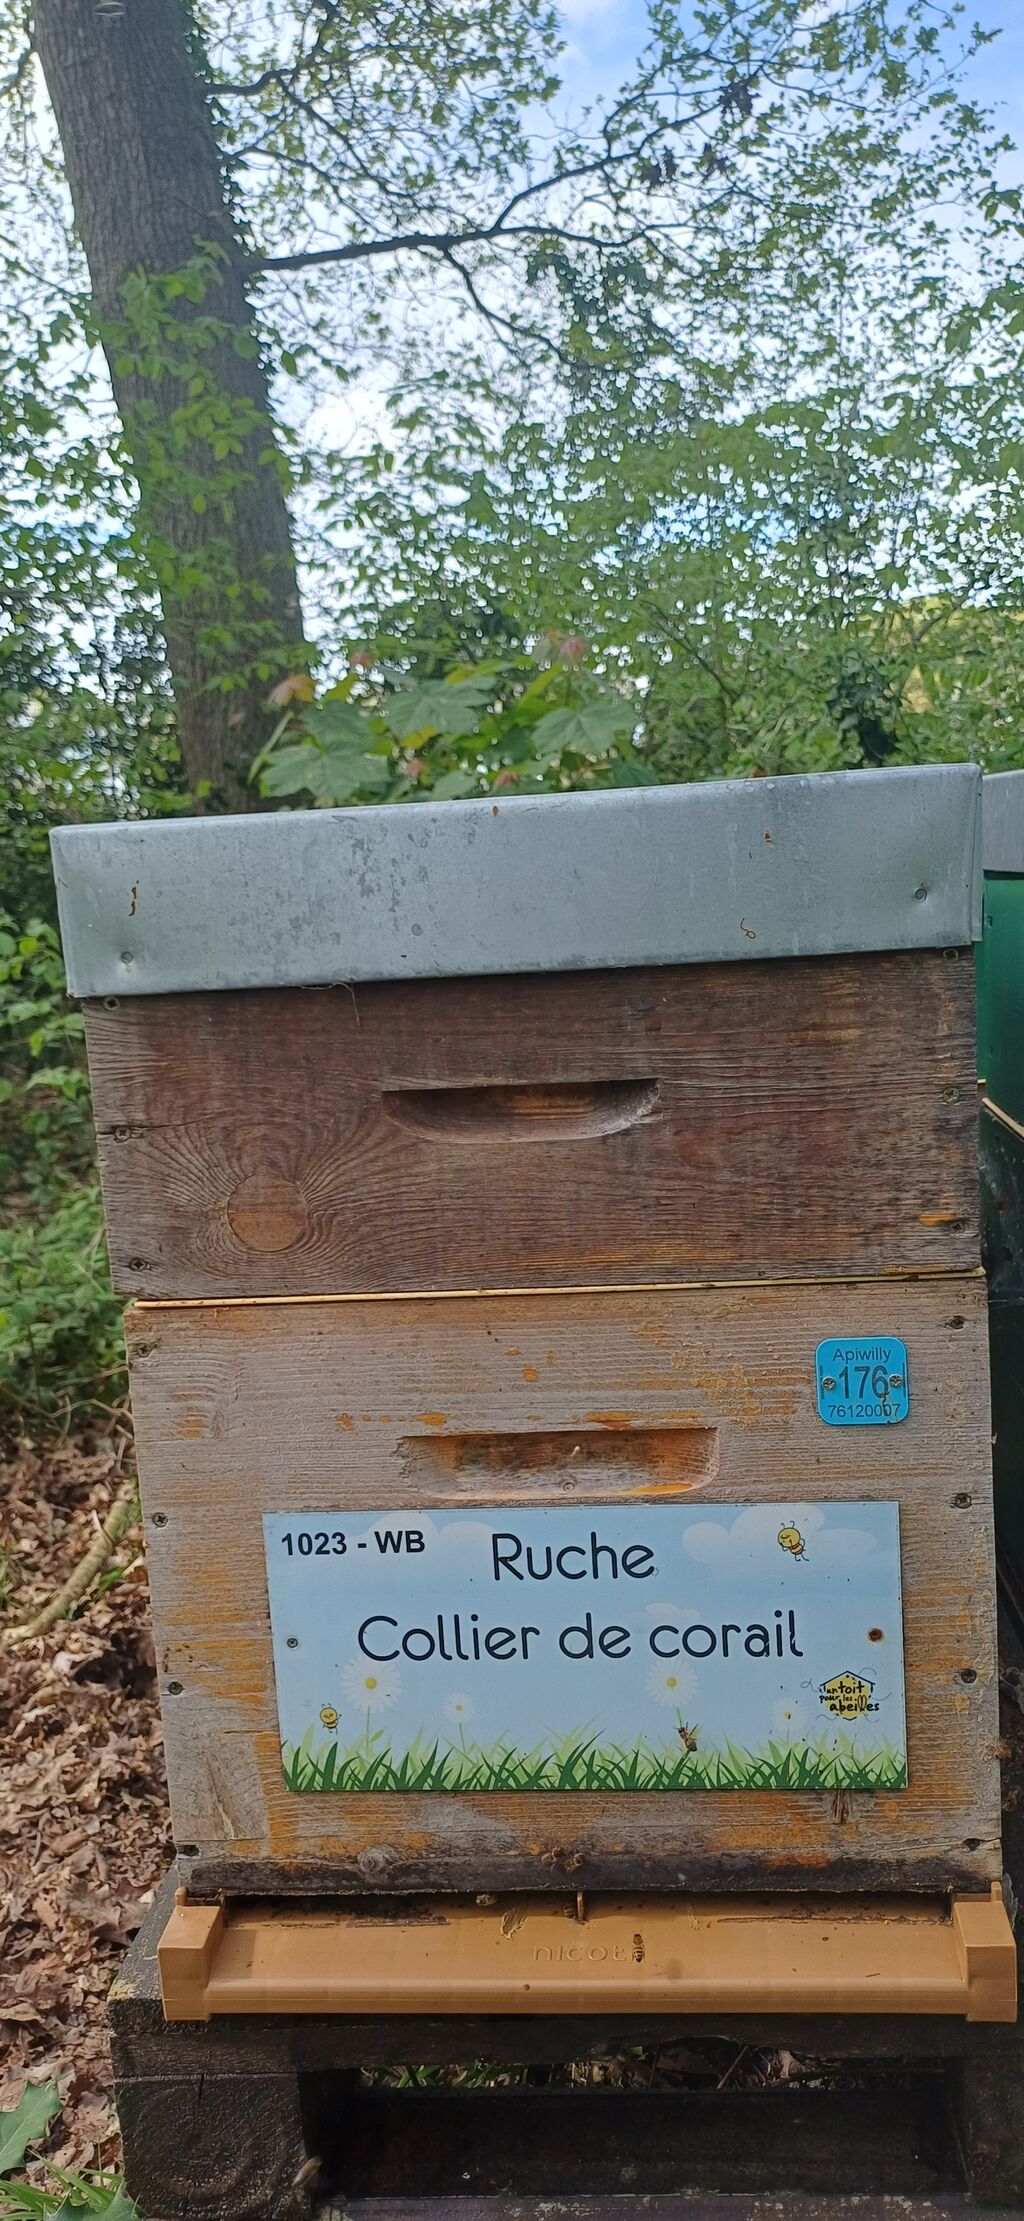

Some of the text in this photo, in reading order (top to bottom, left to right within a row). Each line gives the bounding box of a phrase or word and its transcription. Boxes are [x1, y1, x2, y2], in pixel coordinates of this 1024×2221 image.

[833, 1347, 891, 1364] Apiwilly
[839, 1365, 889, 1399] 176
[828, 1404, 900, 1417] 76120007
[281, 1532, 348, 1556] 1023
[374, 1530, 426, 1554] WB
[491, 1531, 656, 1581] Ruche
[357, 1609, 804, 1662] Collier de corail
[838, 1680, 865, 1694] toit
[819, 1695, 840, 1704] pour
[829, 1694, 880, 1713] abeilles
